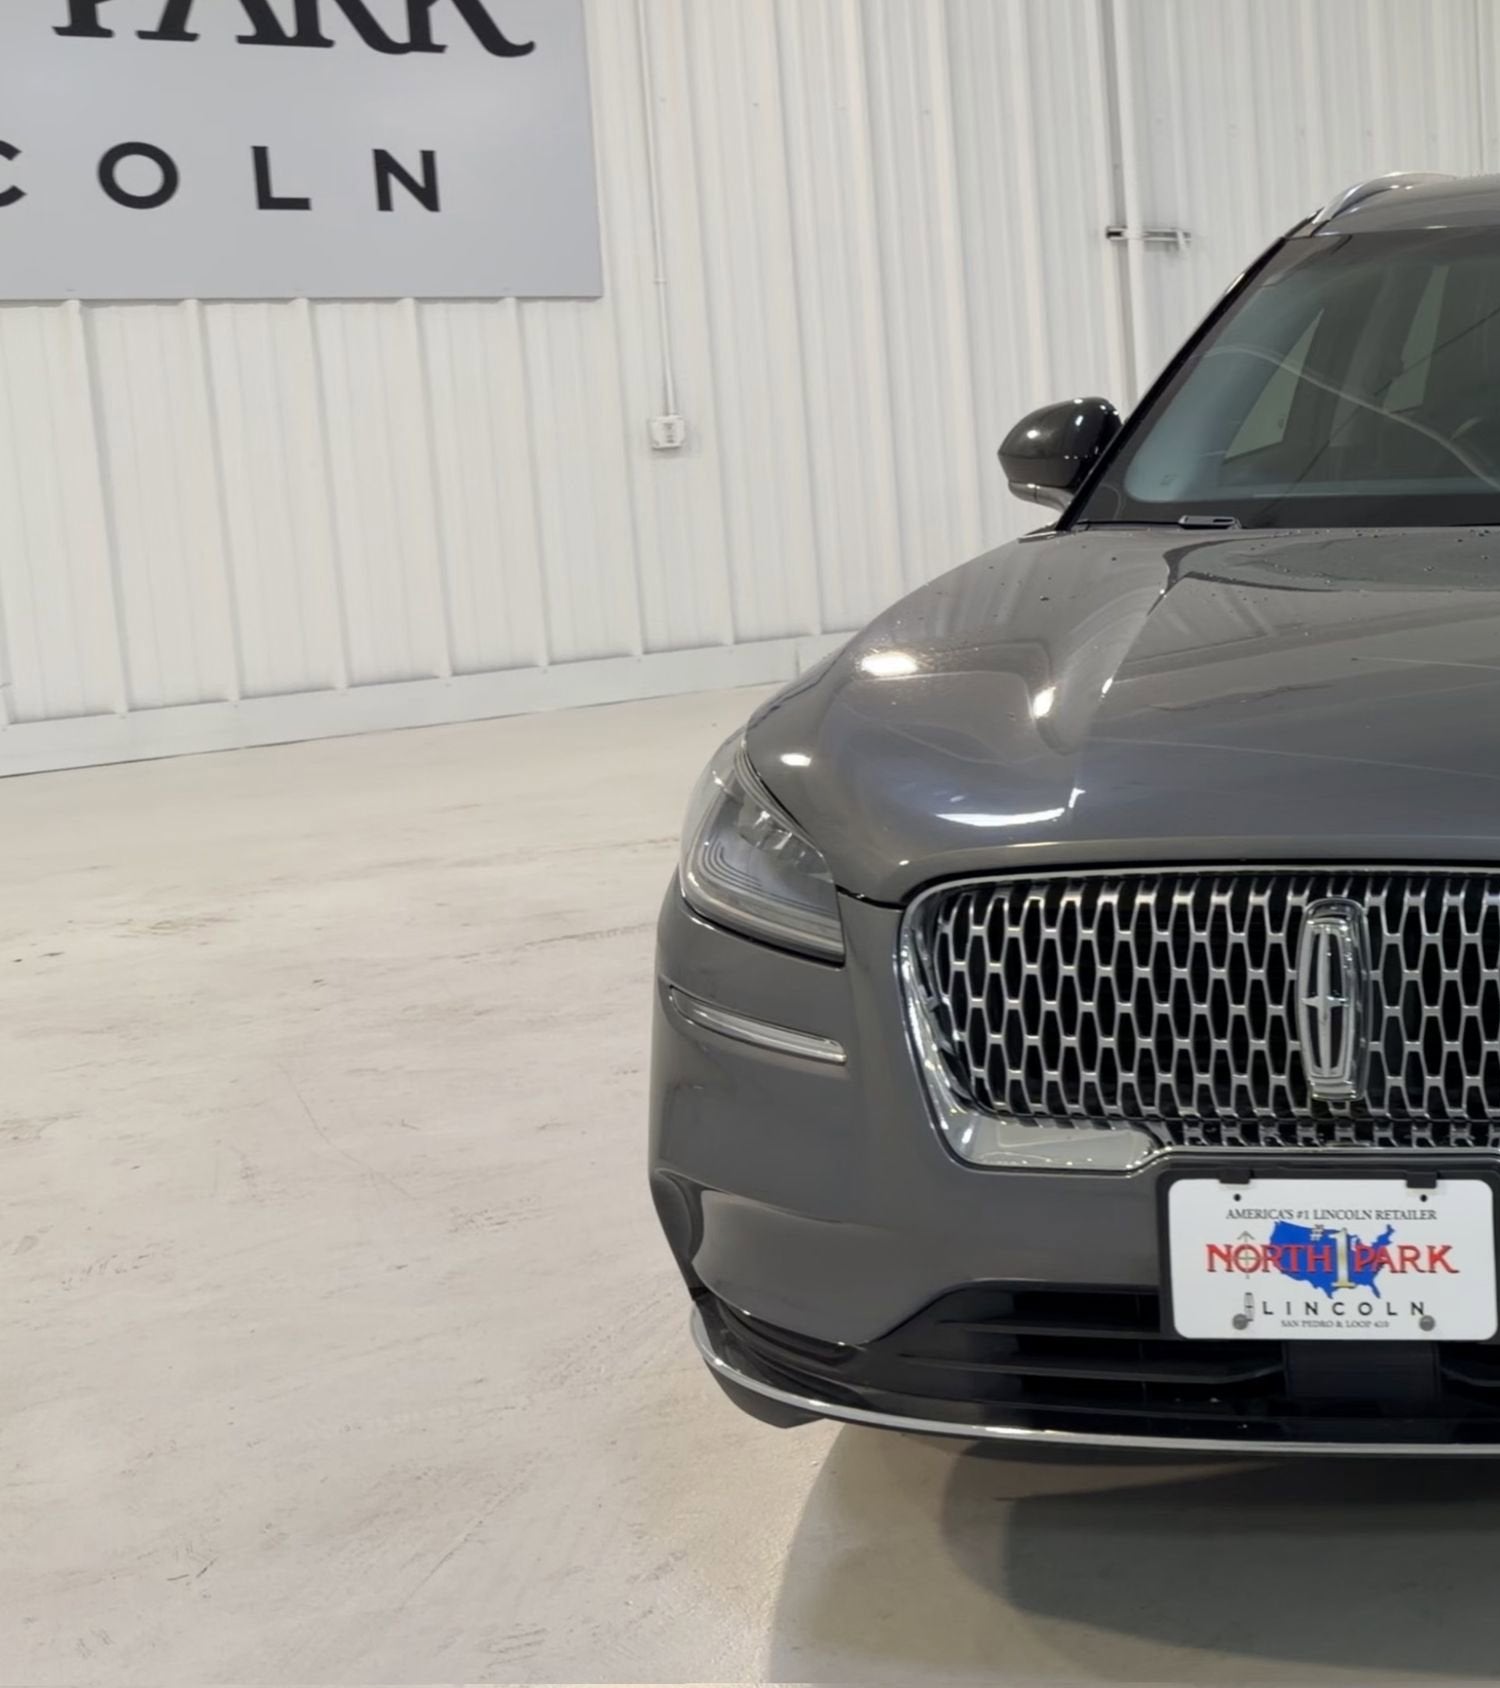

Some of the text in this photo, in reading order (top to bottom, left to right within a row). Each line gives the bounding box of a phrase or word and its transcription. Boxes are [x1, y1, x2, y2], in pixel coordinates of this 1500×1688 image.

[1225, 1209, 1438, 1221] AMERICA'S #1 LINCOLN RETAILER
[1206, 1243, 1461, 1275] NORTH PARK
[1262, 1300, 1426, 1316] LINCOLN
[1280, 1319, 1299, 1328] SAN
[1301, 1319, 1334, 1328] PEDRO
[1346, 1319, 1372, 1328] LOOP
